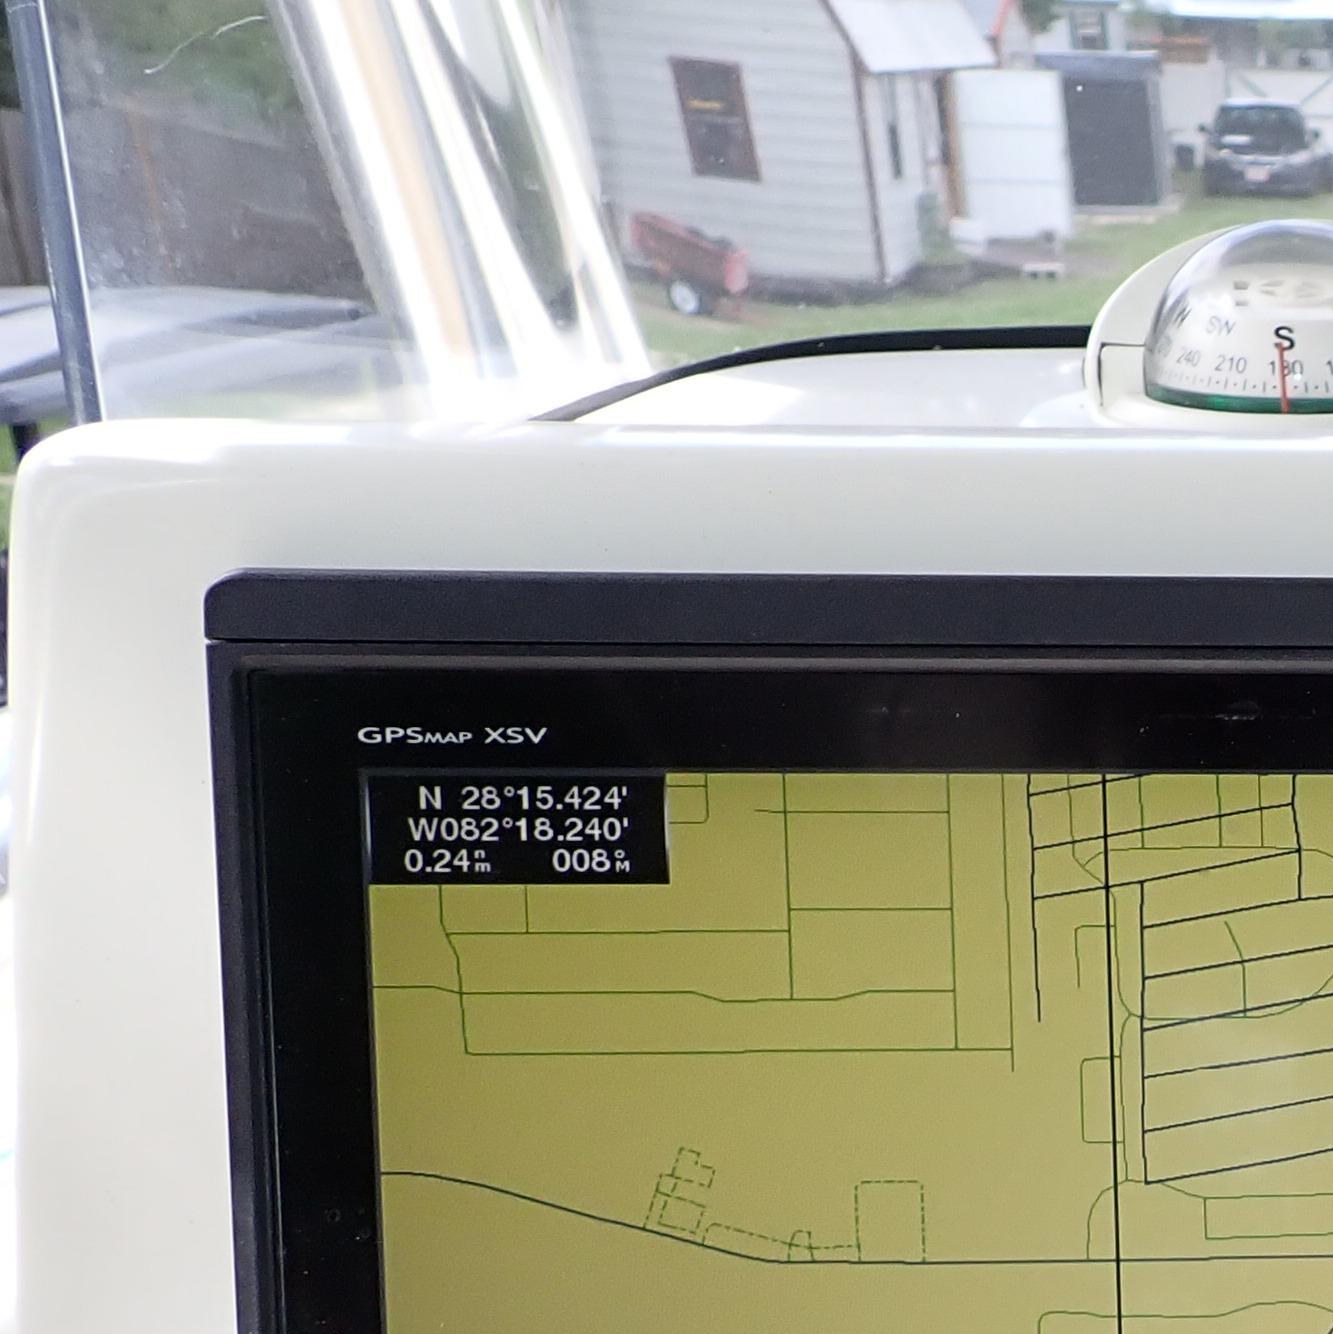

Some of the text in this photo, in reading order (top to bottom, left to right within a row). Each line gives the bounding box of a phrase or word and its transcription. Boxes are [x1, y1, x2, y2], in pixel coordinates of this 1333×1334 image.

[1274, 325, 1295, 351] S
[1214, 354, 1247, 374] 210
[484, 727, 548, 744] XSV
[419, 786, 442, 811] N
